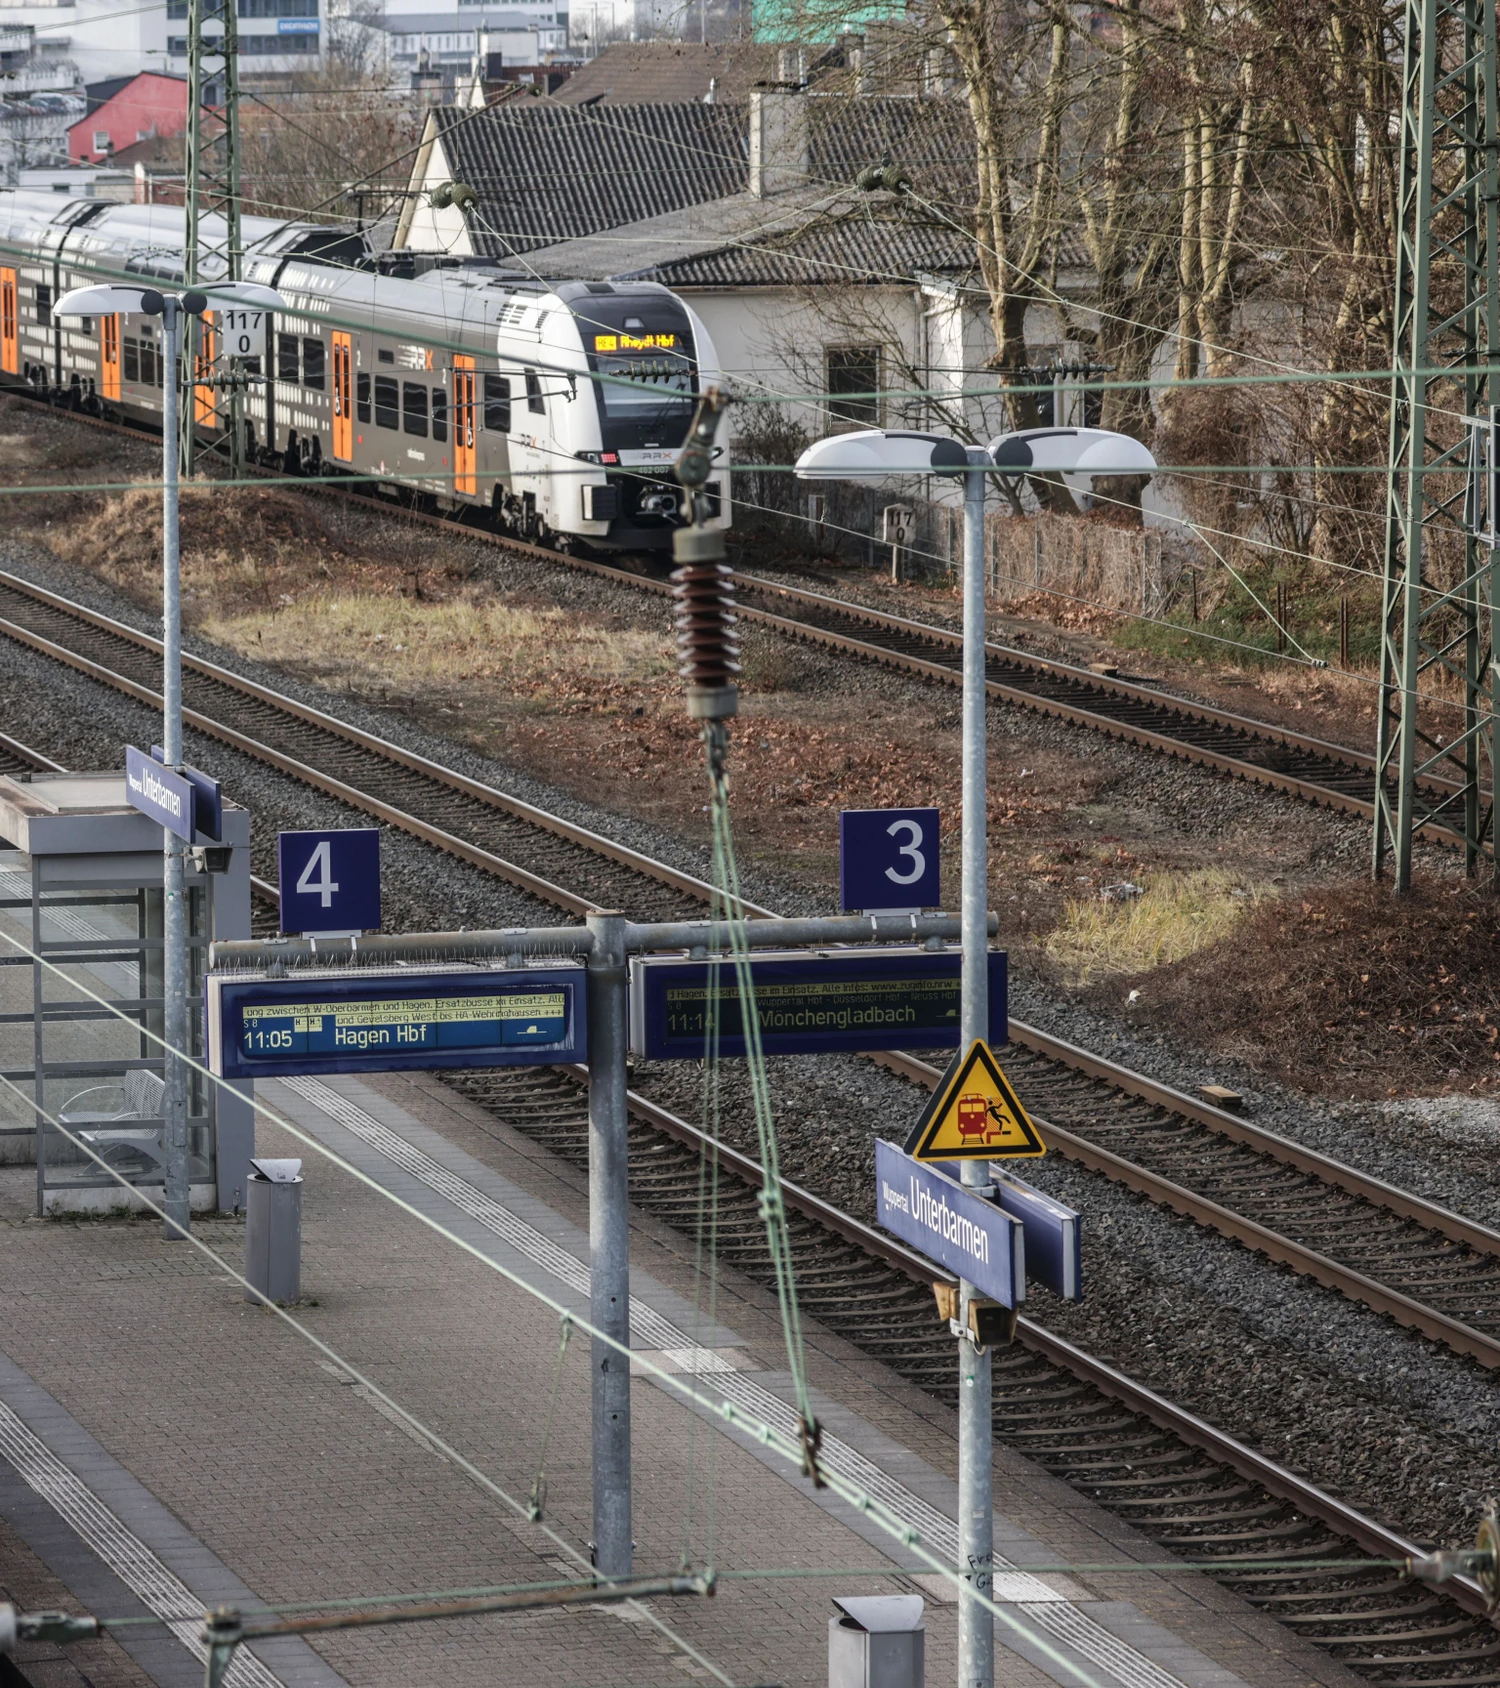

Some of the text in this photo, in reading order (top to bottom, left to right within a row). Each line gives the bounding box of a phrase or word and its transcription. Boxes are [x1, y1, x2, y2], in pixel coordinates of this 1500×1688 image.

[226, 310, 263, 330] 117
[238, 334, 251, 353] 0
[620, 335, 654, 350] Rheydt
[656, 334, 675, 347] Hbf
[143, 767, 181, 818] Unterbarmen
[885, 819, 926, 885] 3
[296, 841, 339, 907] 4
[759, 1005, 916, 1029] Mönchengladbach
[243, 1030, 293, 1049] 11:05
[335, 1024, 427, 1049] Hagen Hbf
[910, 1175, 989, 1265] Unterbarmen
